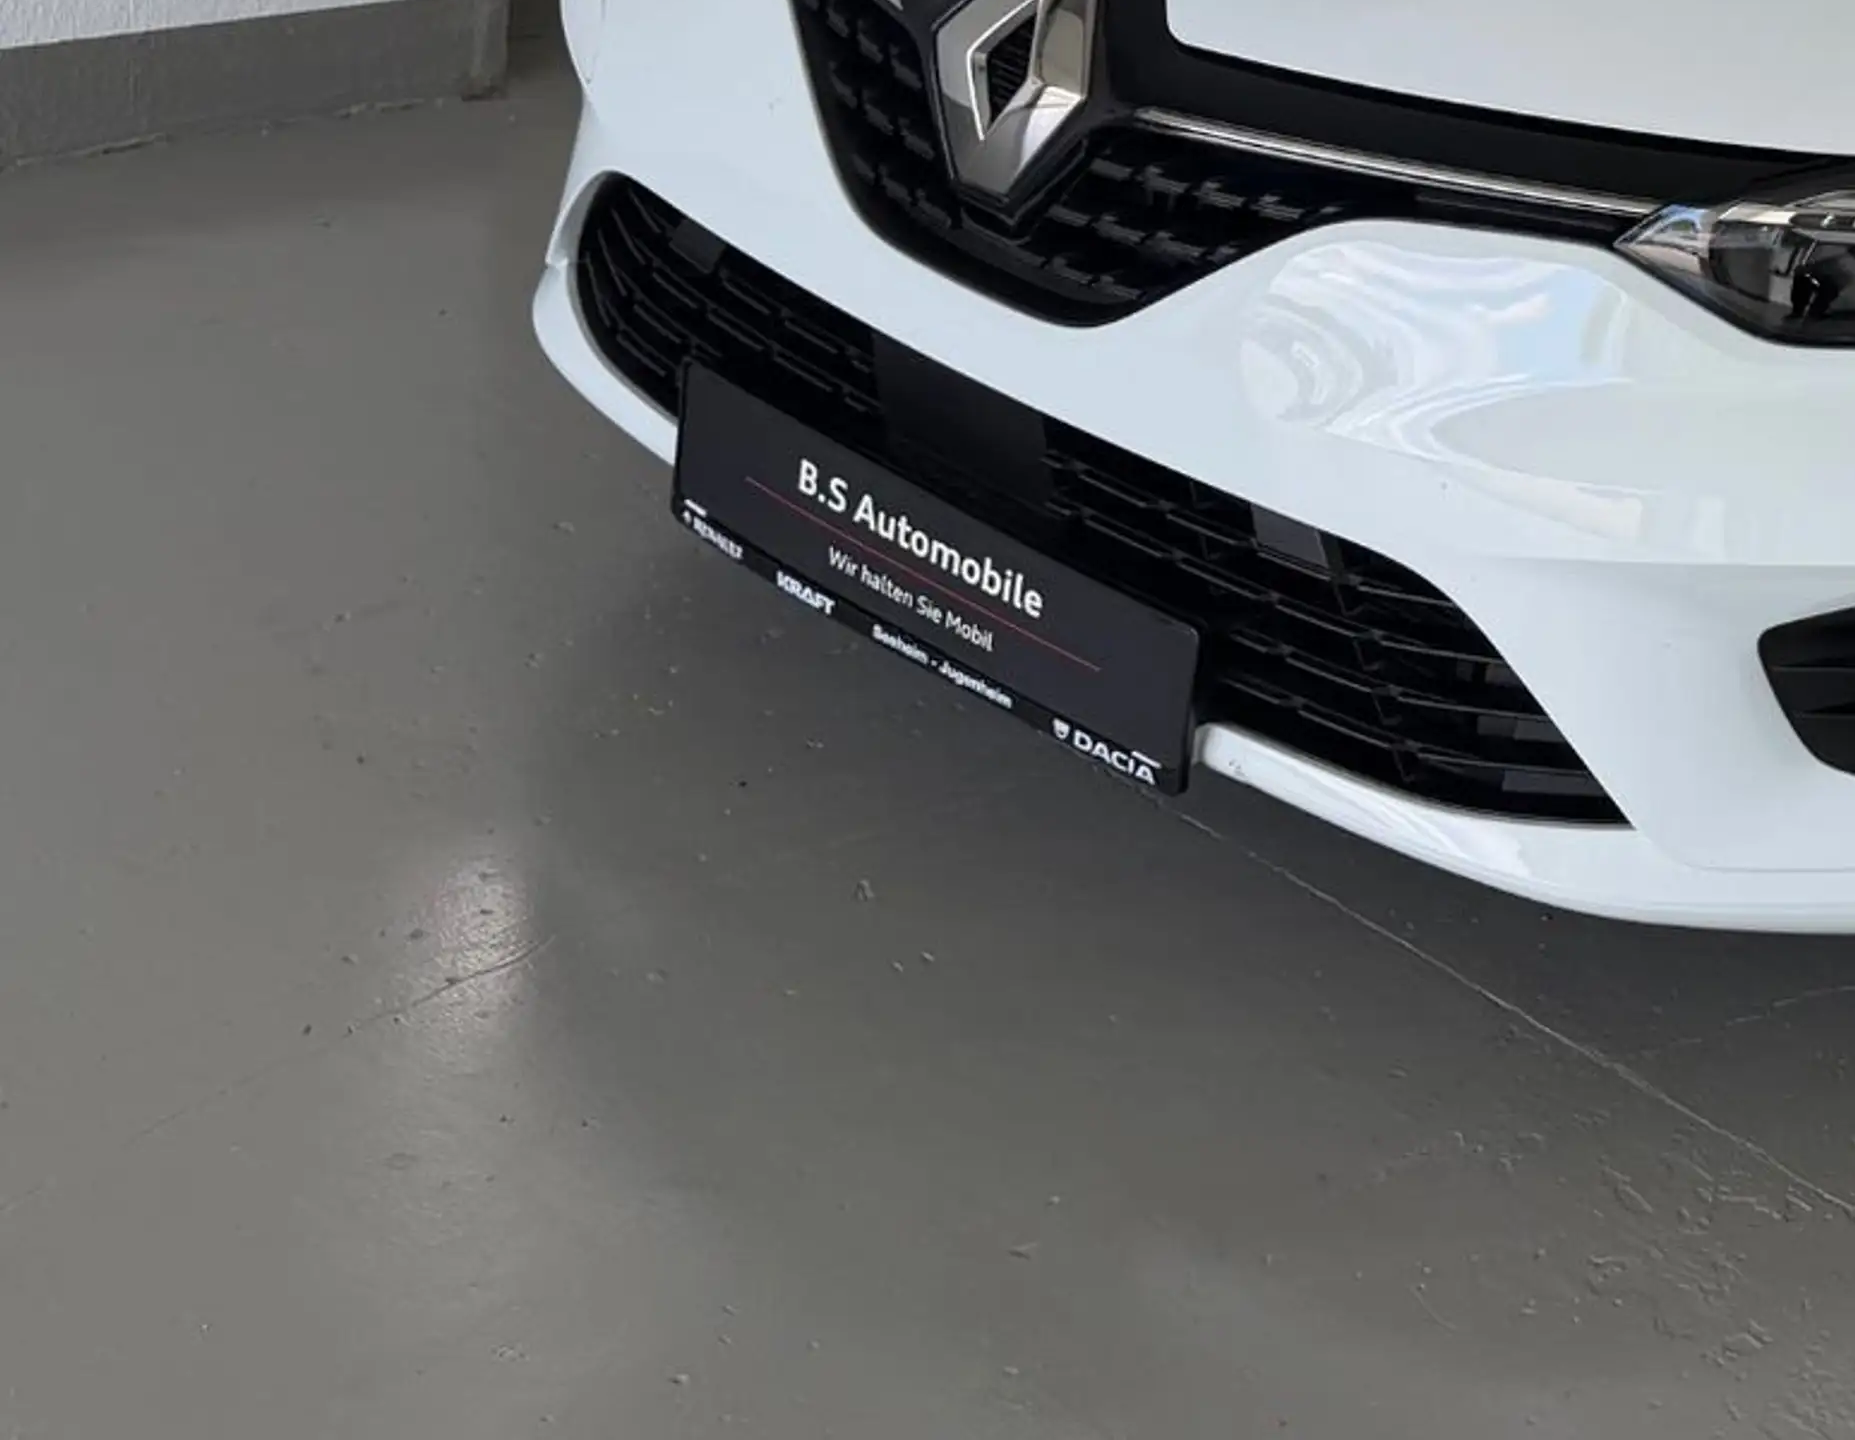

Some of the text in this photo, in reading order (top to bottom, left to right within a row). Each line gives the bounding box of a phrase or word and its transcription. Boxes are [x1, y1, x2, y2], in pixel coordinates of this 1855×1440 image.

[798, 458, 1044, 619] B.S Automobile
[776, 569, 836, 616] KRAFT
[828, 545, 993, 653] Wir halten Sie Mobil
[1073, 728, 1156, 786] DACIA
